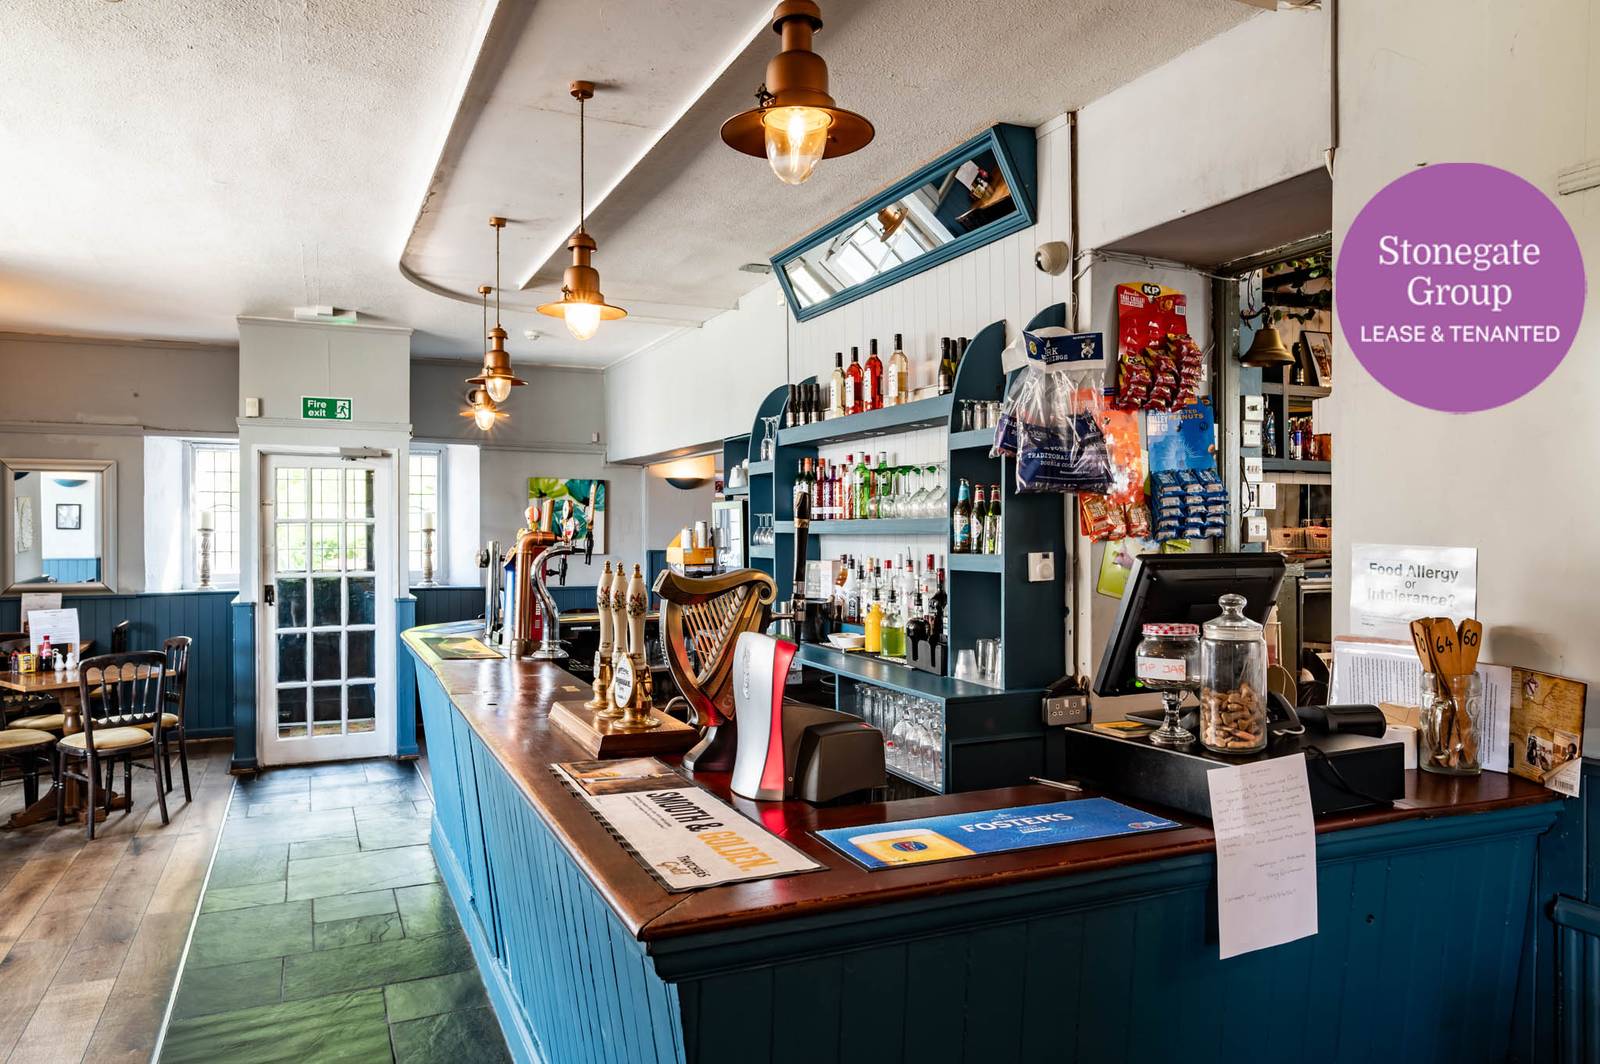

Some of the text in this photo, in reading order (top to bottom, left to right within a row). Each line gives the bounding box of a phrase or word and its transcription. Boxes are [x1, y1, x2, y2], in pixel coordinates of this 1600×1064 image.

[1143, 285, 1160, 294] KP
[308, 400, 327, 408] Fire
[308, 409, 326, 417] exit
[1369, 562, 1459, 583] Food Allergy
[1405, 580, 1416, 589] or
[1367, 587, 1455, 607] Intolerance?
[1436, 636, 1453, 654] 64
[1463, 629, 1478, 647] 60
[1139, 663, 1185, 674] TIP JAR
[646, 791, 715, 823] SMOOTH
[685, 822, 724, 833] &
[960, 813, 1074, 833] FOSTER'S
